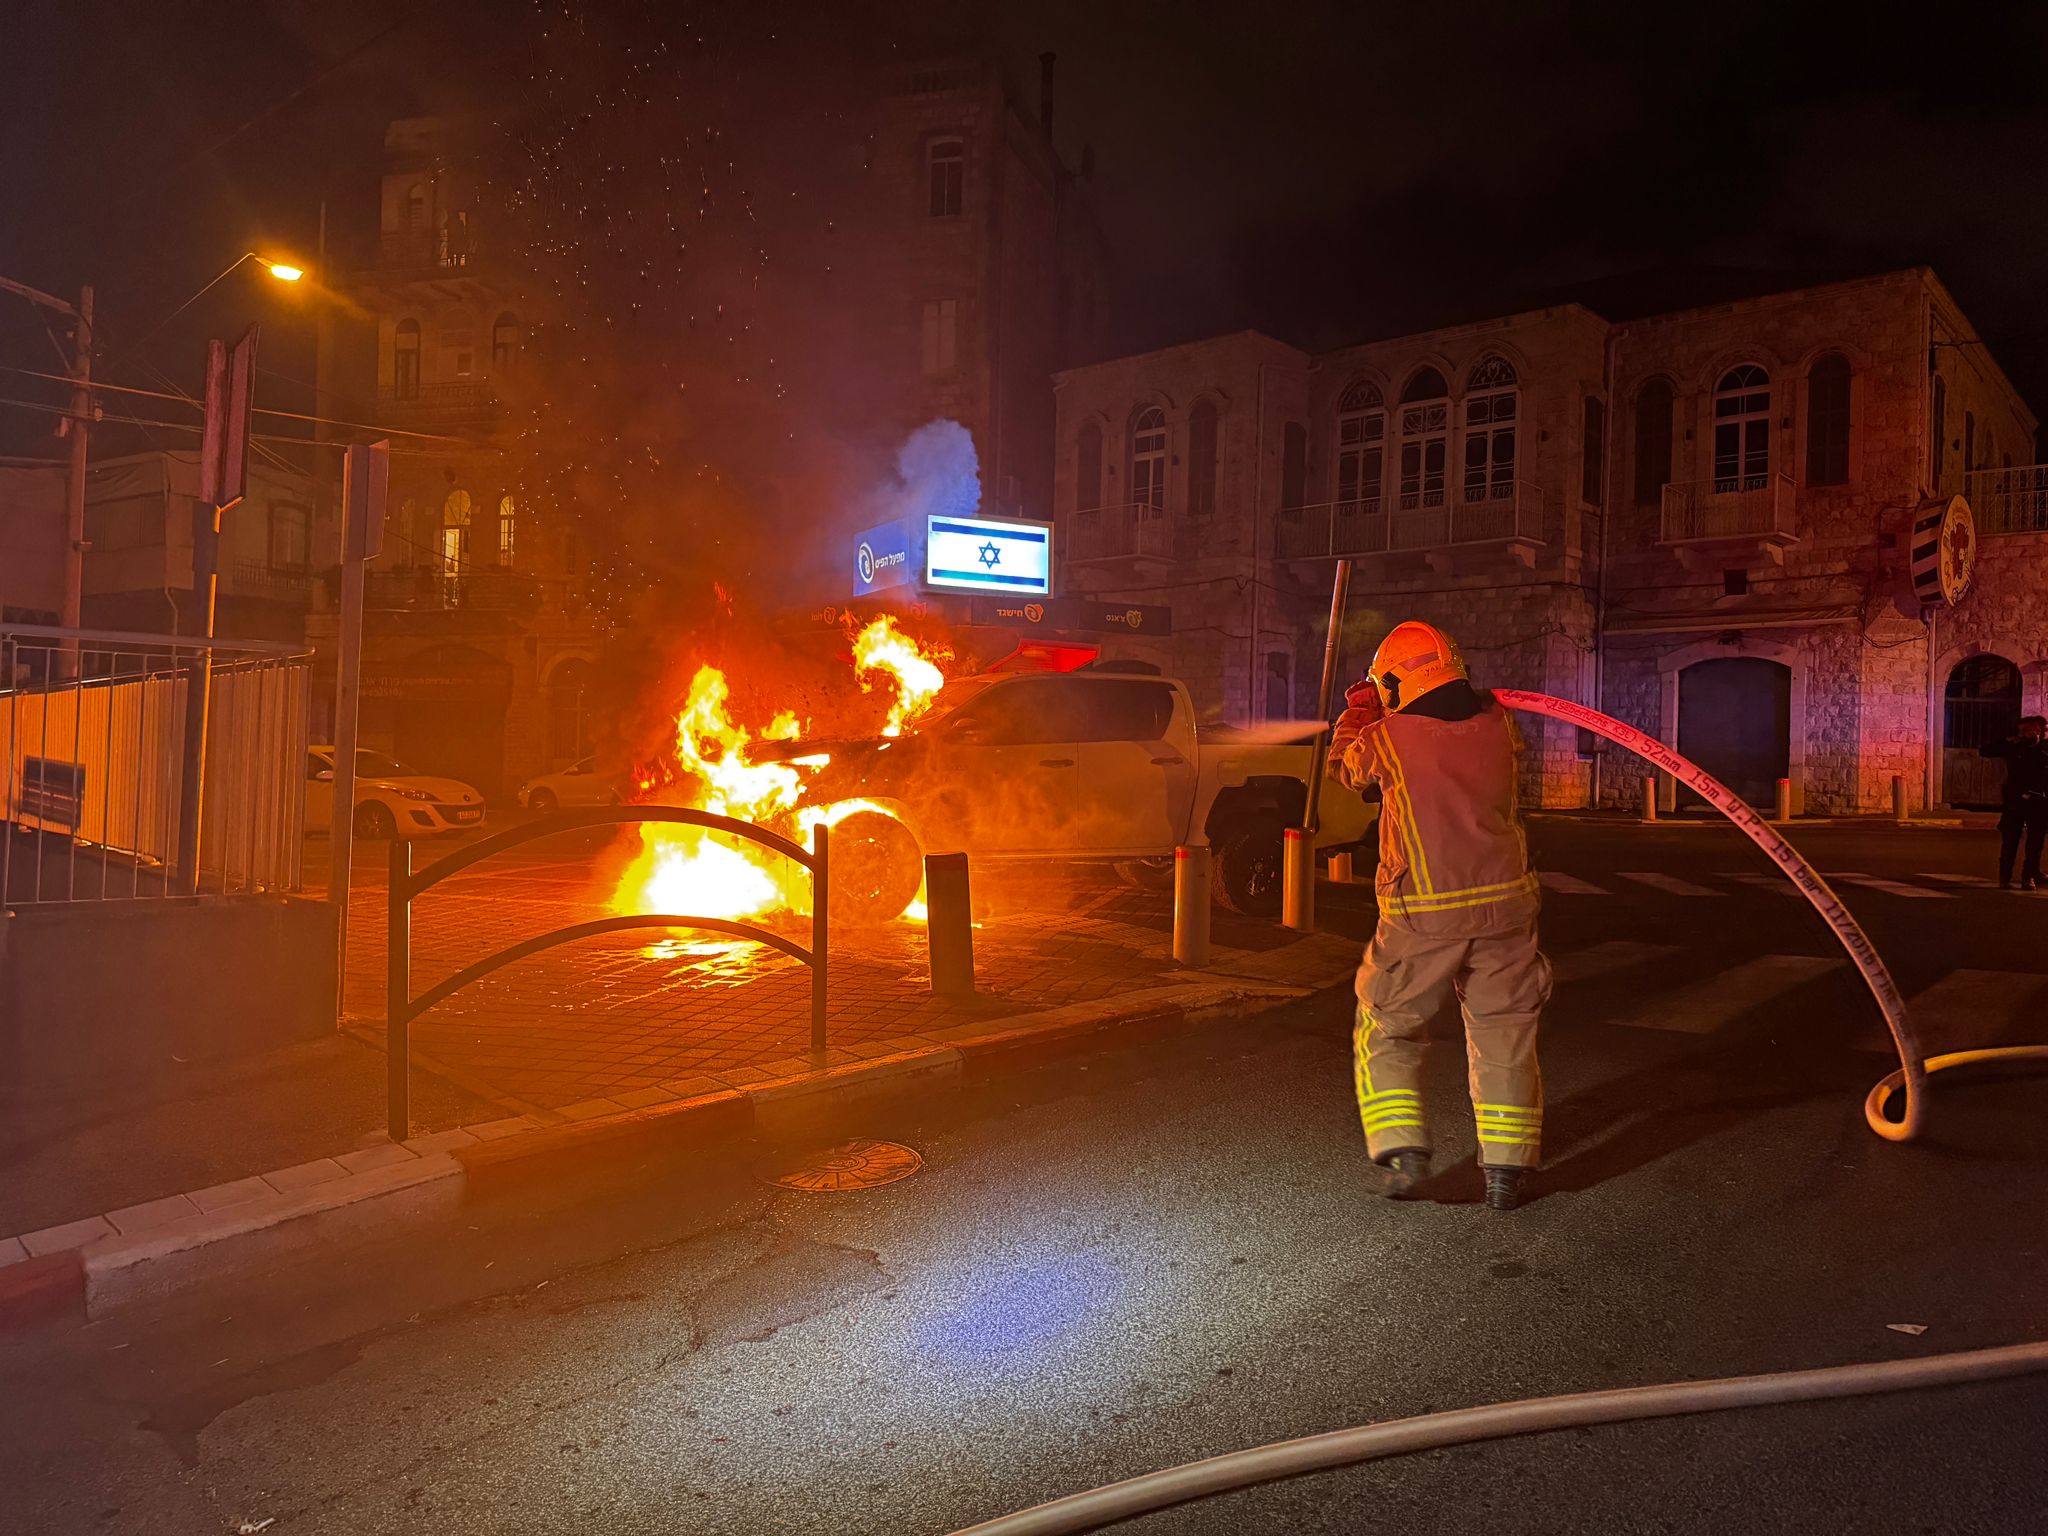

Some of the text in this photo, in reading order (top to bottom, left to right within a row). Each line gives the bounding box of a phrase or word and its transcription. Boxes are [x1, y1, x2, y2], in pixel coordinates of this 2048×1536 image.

[875, 551, 905, 569] מפעל הפיס
[996, 608, 1023, 617] חישגד
[1640, 739, 1682, 773] 52mm
[1687, 770, 1720, 800] 15m
[1726, 798, 1761, 837] W.P.
[1769, 840, 1791, 862] 15
[1793, 864, 1823, 893] bar
